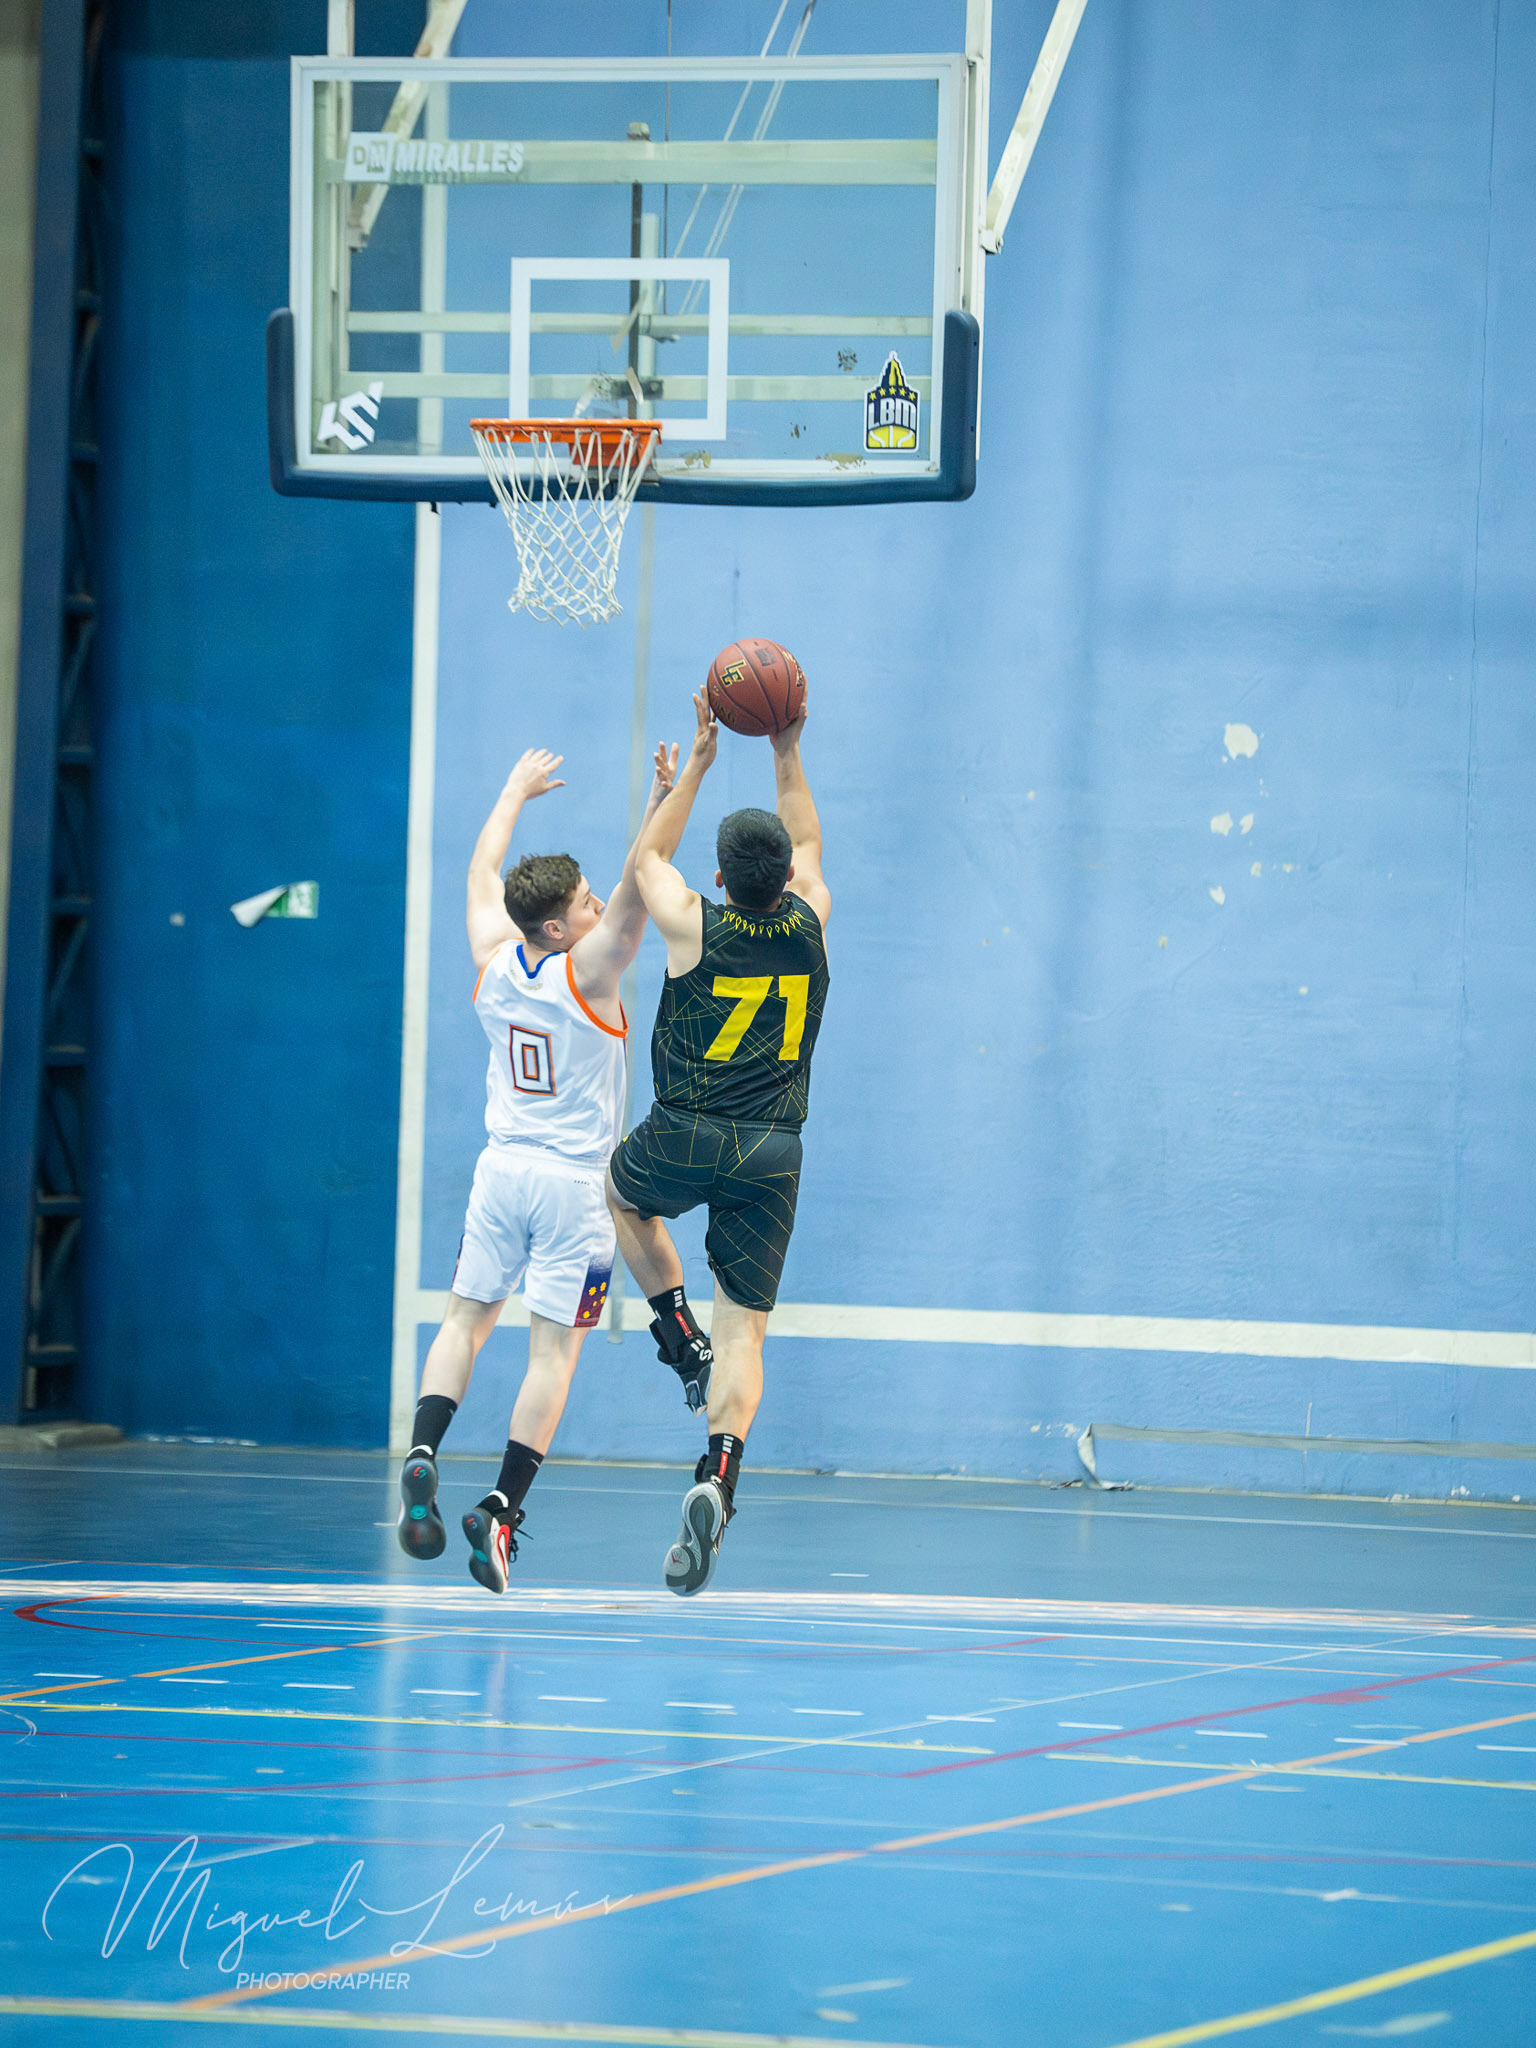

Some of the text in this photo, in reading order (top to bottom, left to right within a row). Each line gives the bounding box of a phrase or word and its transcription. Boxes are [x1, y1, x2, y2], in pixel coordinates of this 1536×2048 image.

[394, 141, 524, 174] MIRALLES
[867, 397, 917, 431] LBM
[703, 974, 810, 1062] 71
[509, 1023, 557, 1097] 0
